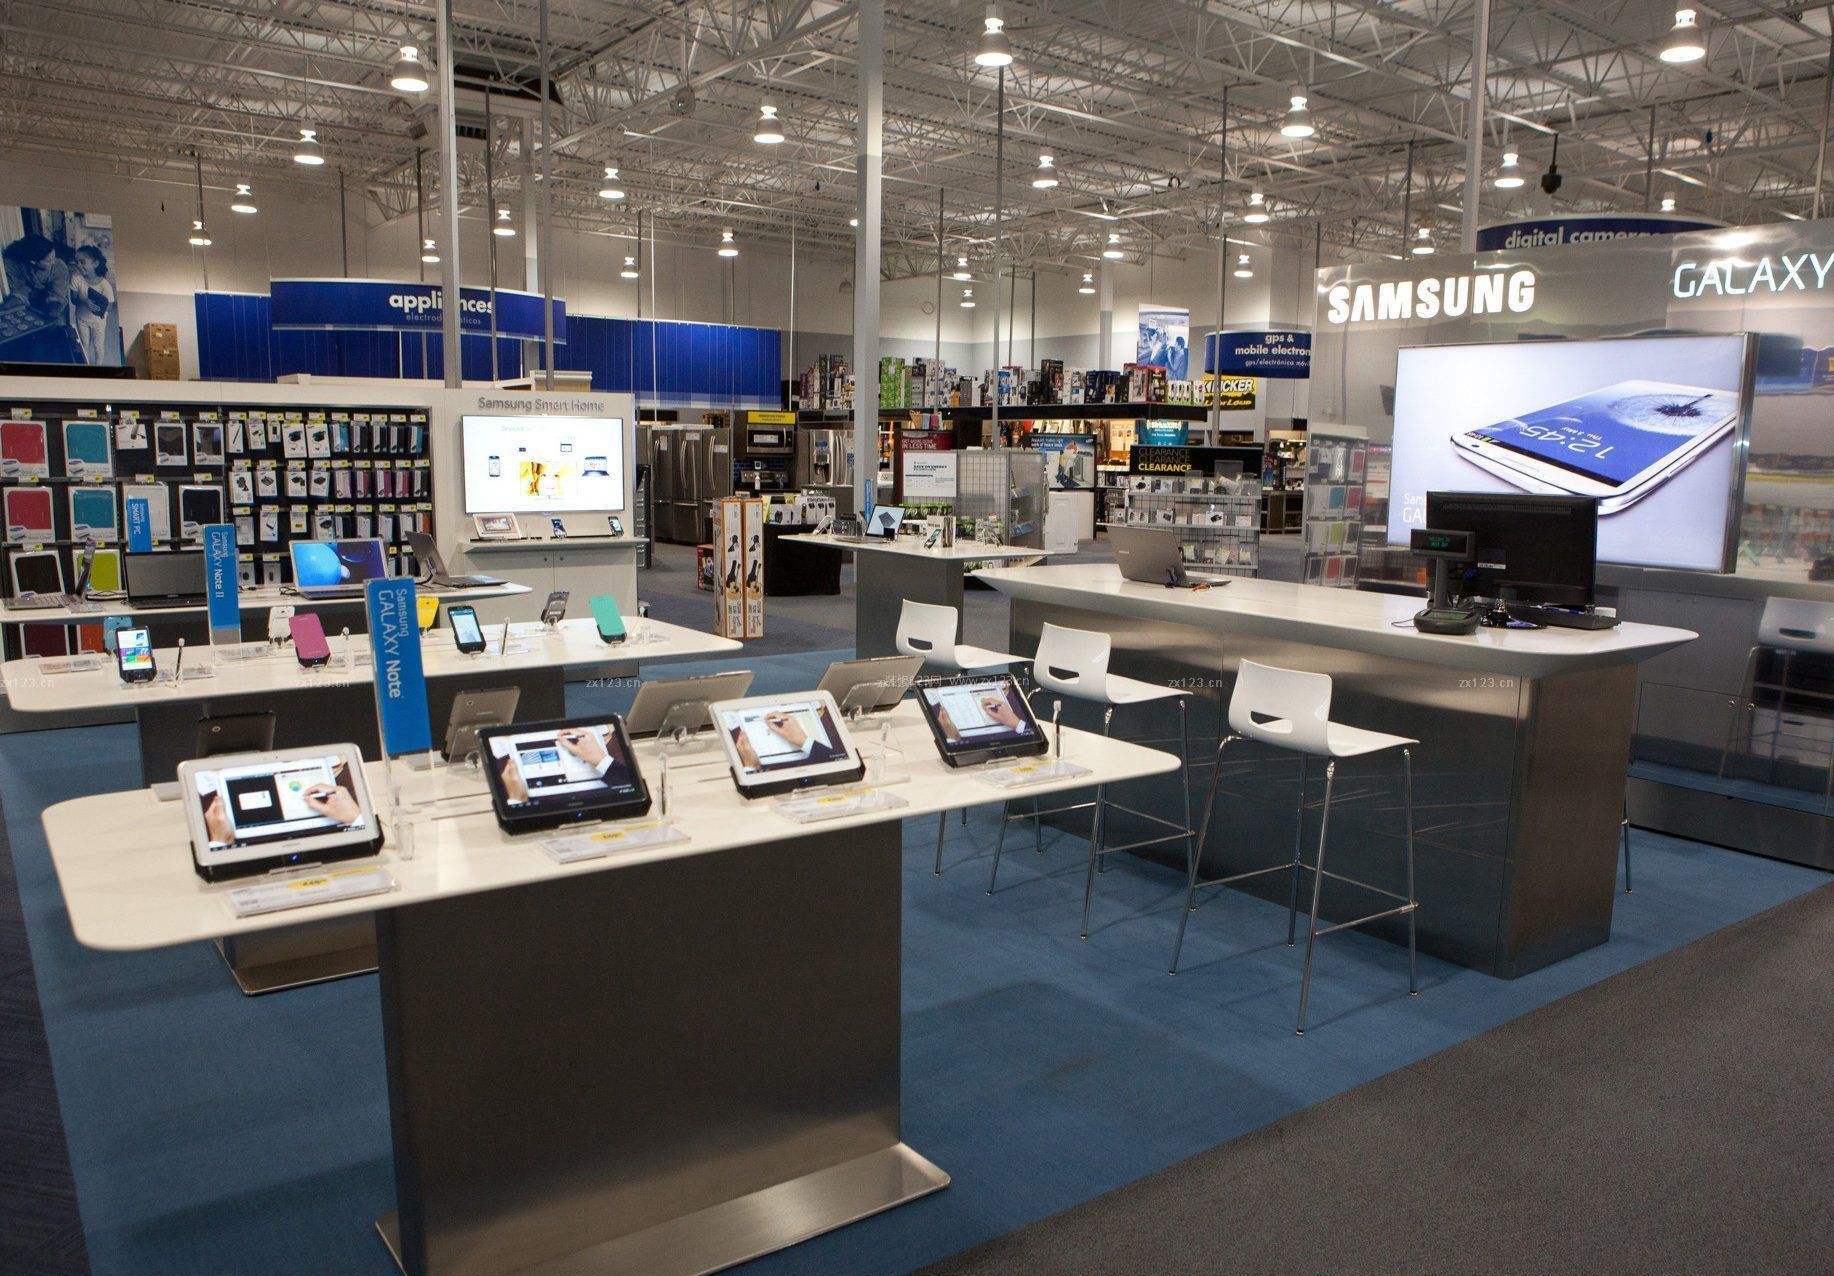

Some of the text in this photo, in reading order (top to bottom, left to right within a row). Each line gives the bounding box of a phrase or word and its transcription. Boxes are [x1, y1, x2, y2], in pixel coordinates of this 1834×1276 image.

[1505, 225, 1565, 249] digital
[1673, 253, 1834, 299] GALAXY
[389, 290, 493, 314] applinces
[1328, 270, 1535, 324] SAMSUNG
[1235, 345, 1268, 355] mobile
[1265, 333, 1295, 344] gps &
[478, 397, 605, 412] Samsung Smart Home
[1519, 425, 1614, 459] 12:45
[1138, 463, 1192, 472] CLEARANCE
[131, 503, 141, 535] SMART PC
[211, 532, 222, 568] GALAXY
[221, 531, 229, 558] Samsung
[214, 568, 223, 590] Note
[396, 588, 409, 637] Samsung
[378, 589, 402, 699] GALAXY Note
